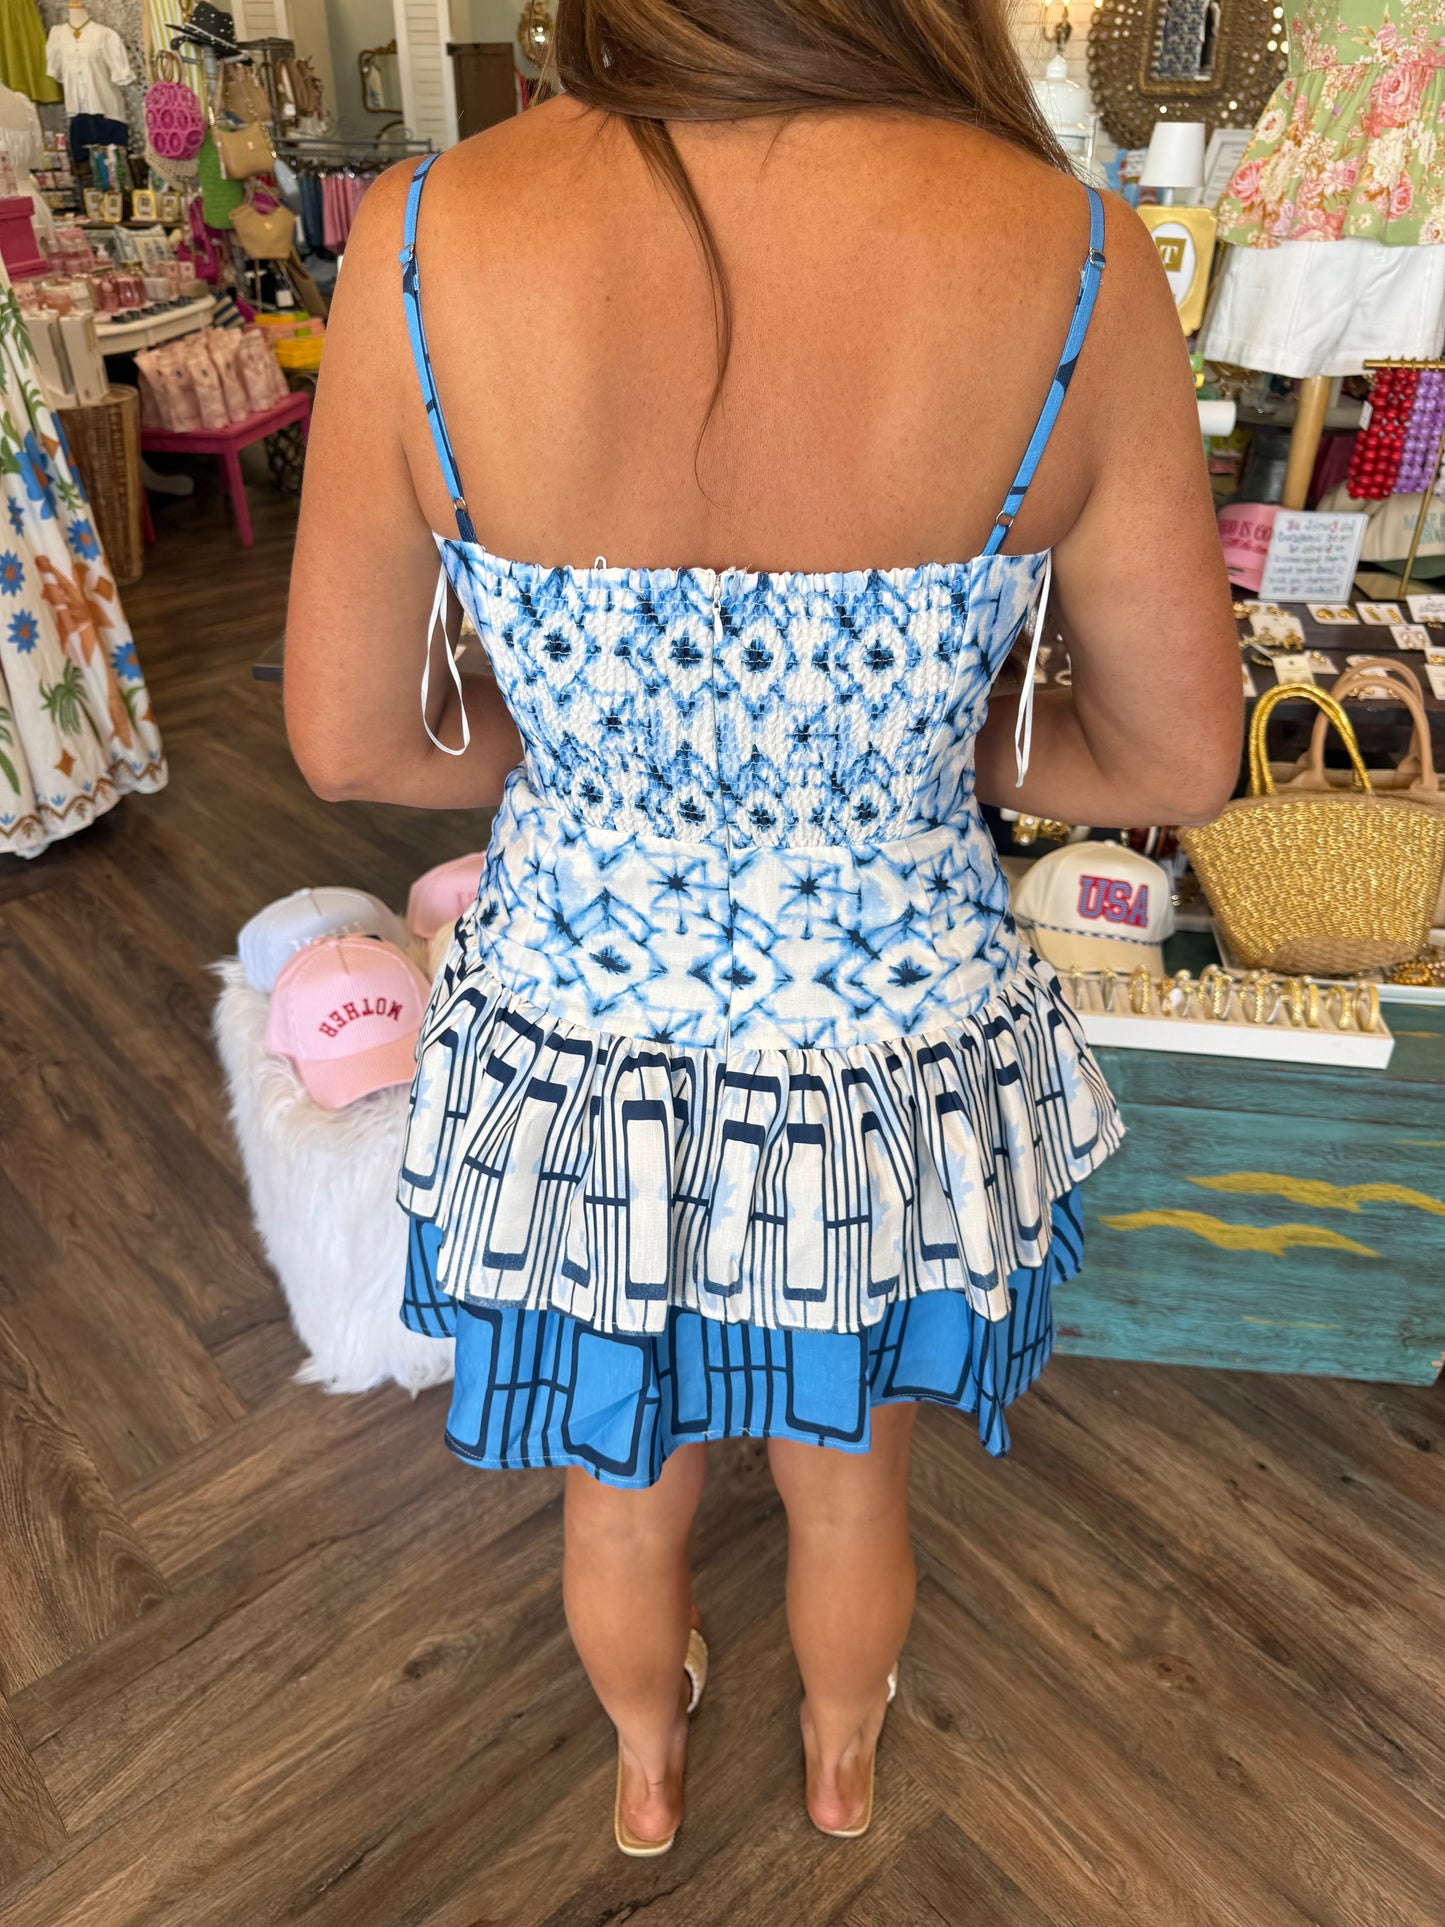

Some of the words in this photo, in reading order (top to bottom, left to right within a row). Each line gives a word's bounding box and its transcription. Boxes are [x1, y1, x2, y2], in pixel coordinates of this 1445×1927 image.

[1159, 244, 1178, 265] T
[1077, 875, 1148, 928] USA
[319, 997, 405, 1039] MOTHER
